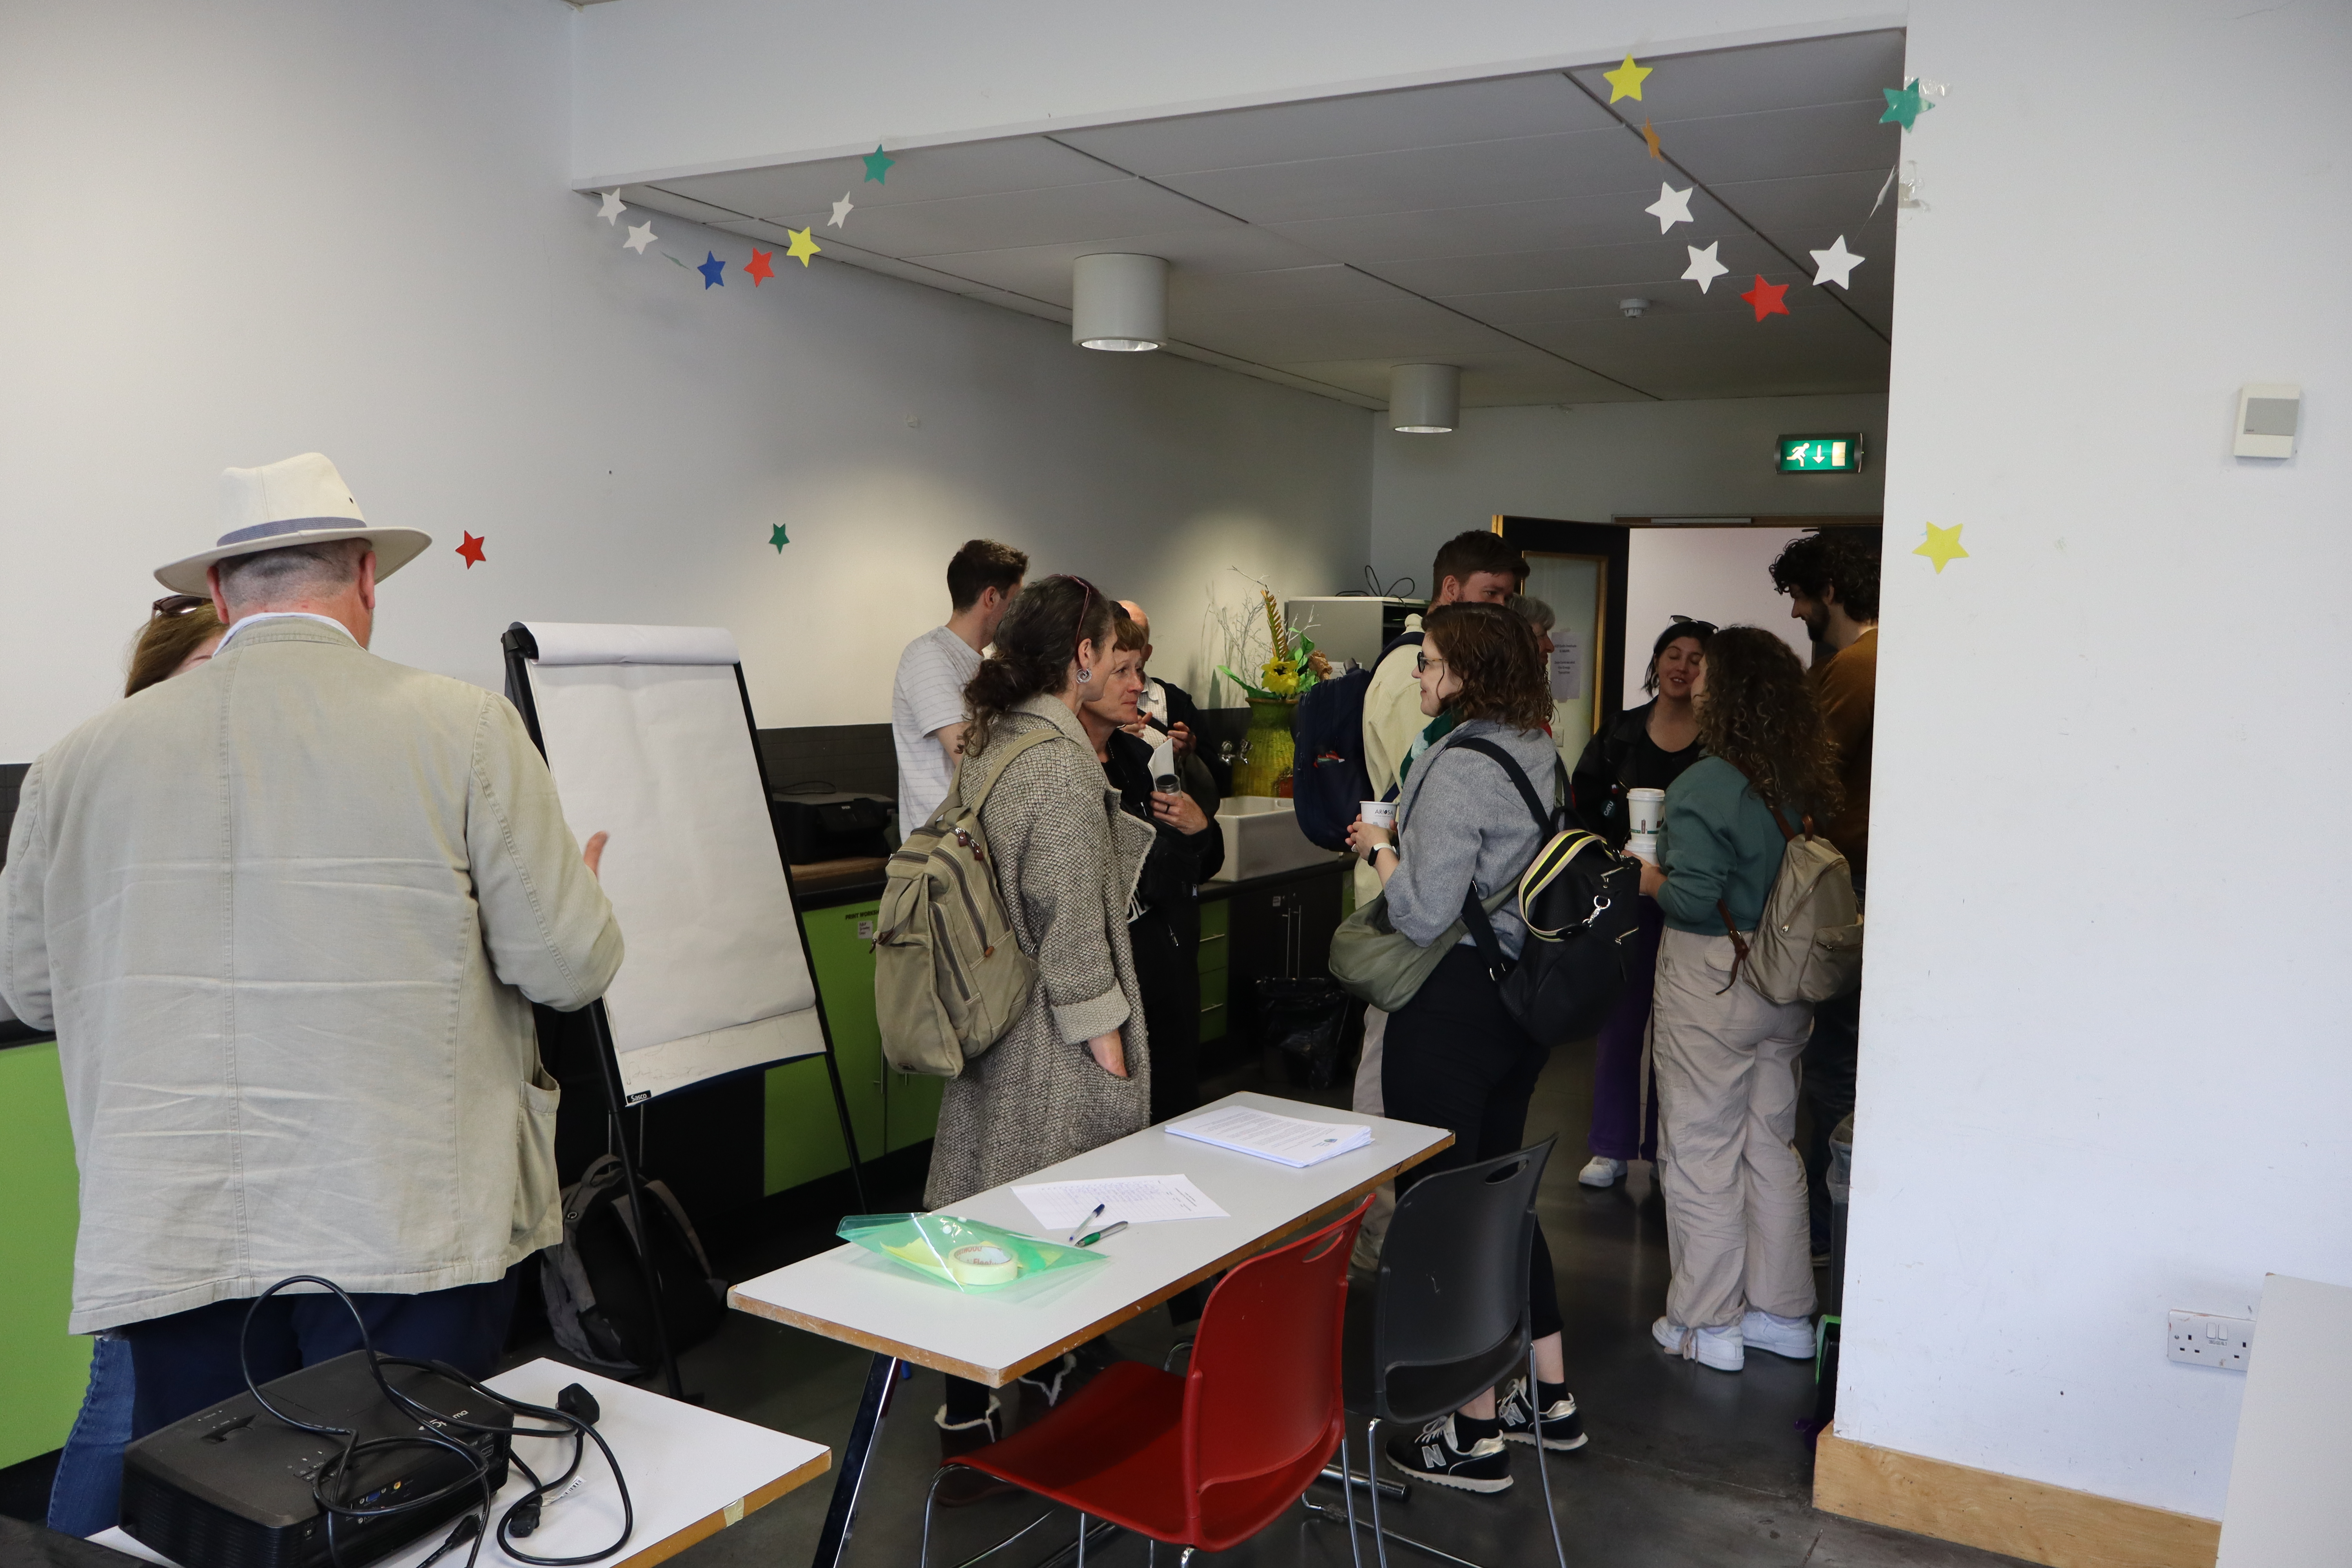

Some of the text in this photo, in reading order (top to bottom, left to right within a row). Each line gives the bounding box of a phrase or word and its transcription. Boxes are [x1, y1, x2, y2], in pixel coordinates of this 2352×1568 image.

[1604, 800, 1613, 816] CATU
[631, 1093, 647, 1102] Sasco
[1421, 1443, 1446, 1468] N
